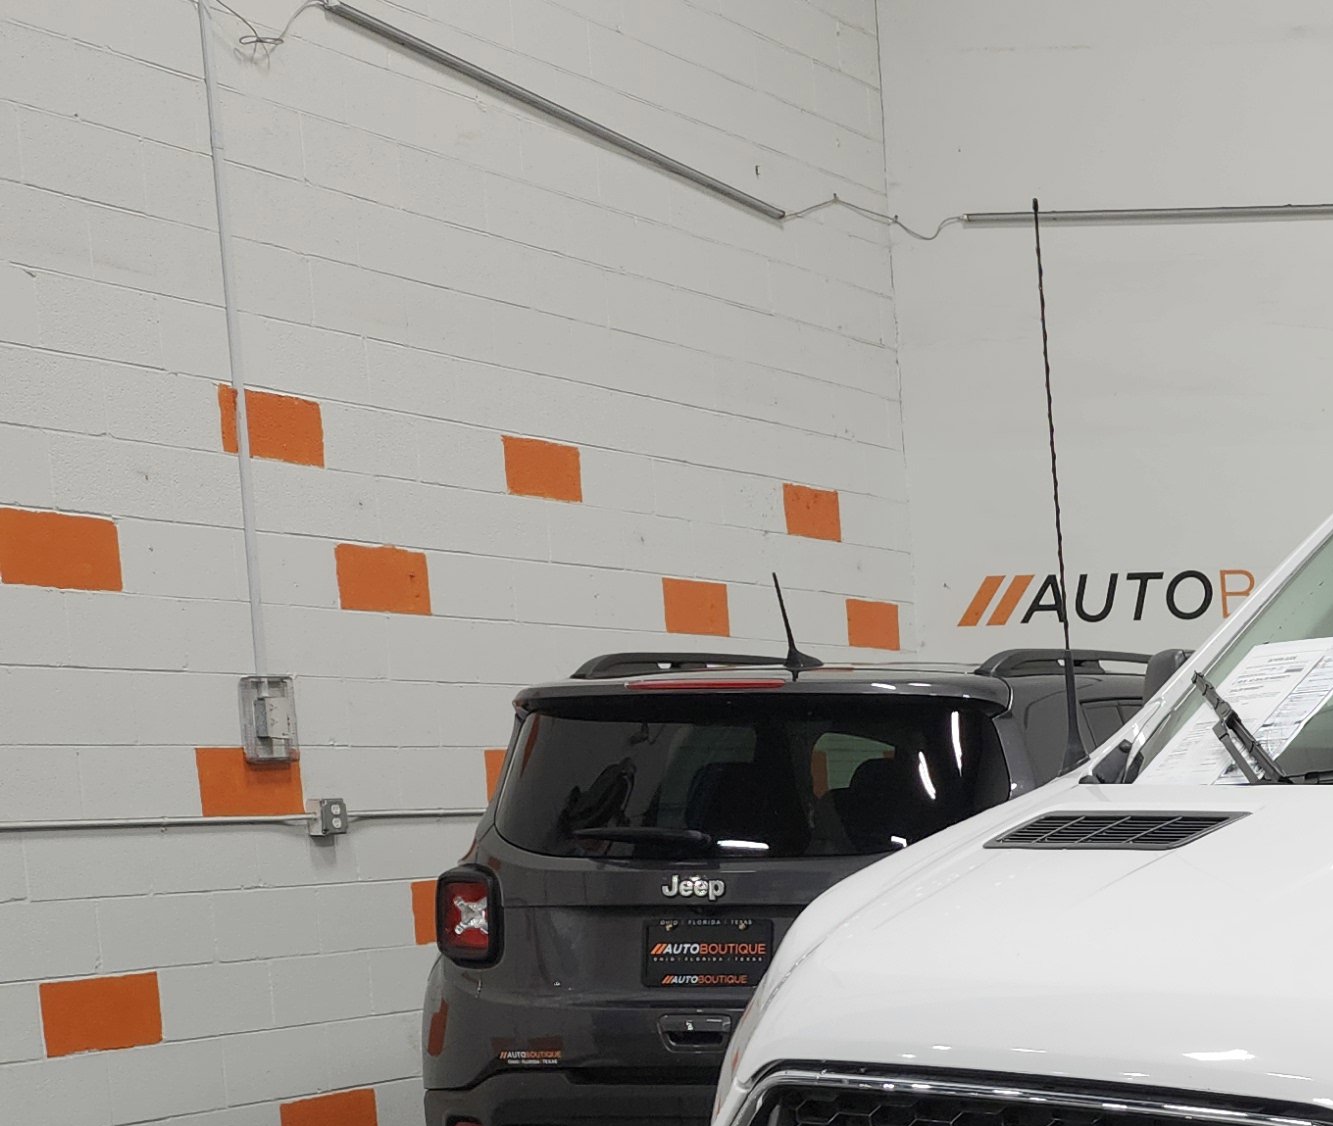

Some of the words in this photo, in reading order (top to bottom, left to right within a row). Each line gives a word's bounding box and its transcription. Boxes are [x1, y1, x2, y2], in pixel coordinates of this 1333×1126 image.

[661, 874, 725, 900] Jeep
[663, 943, 766, 955] AUTOBOUTIQUE
[670, 974, 749, 984] AUTOBOUTIQUE
